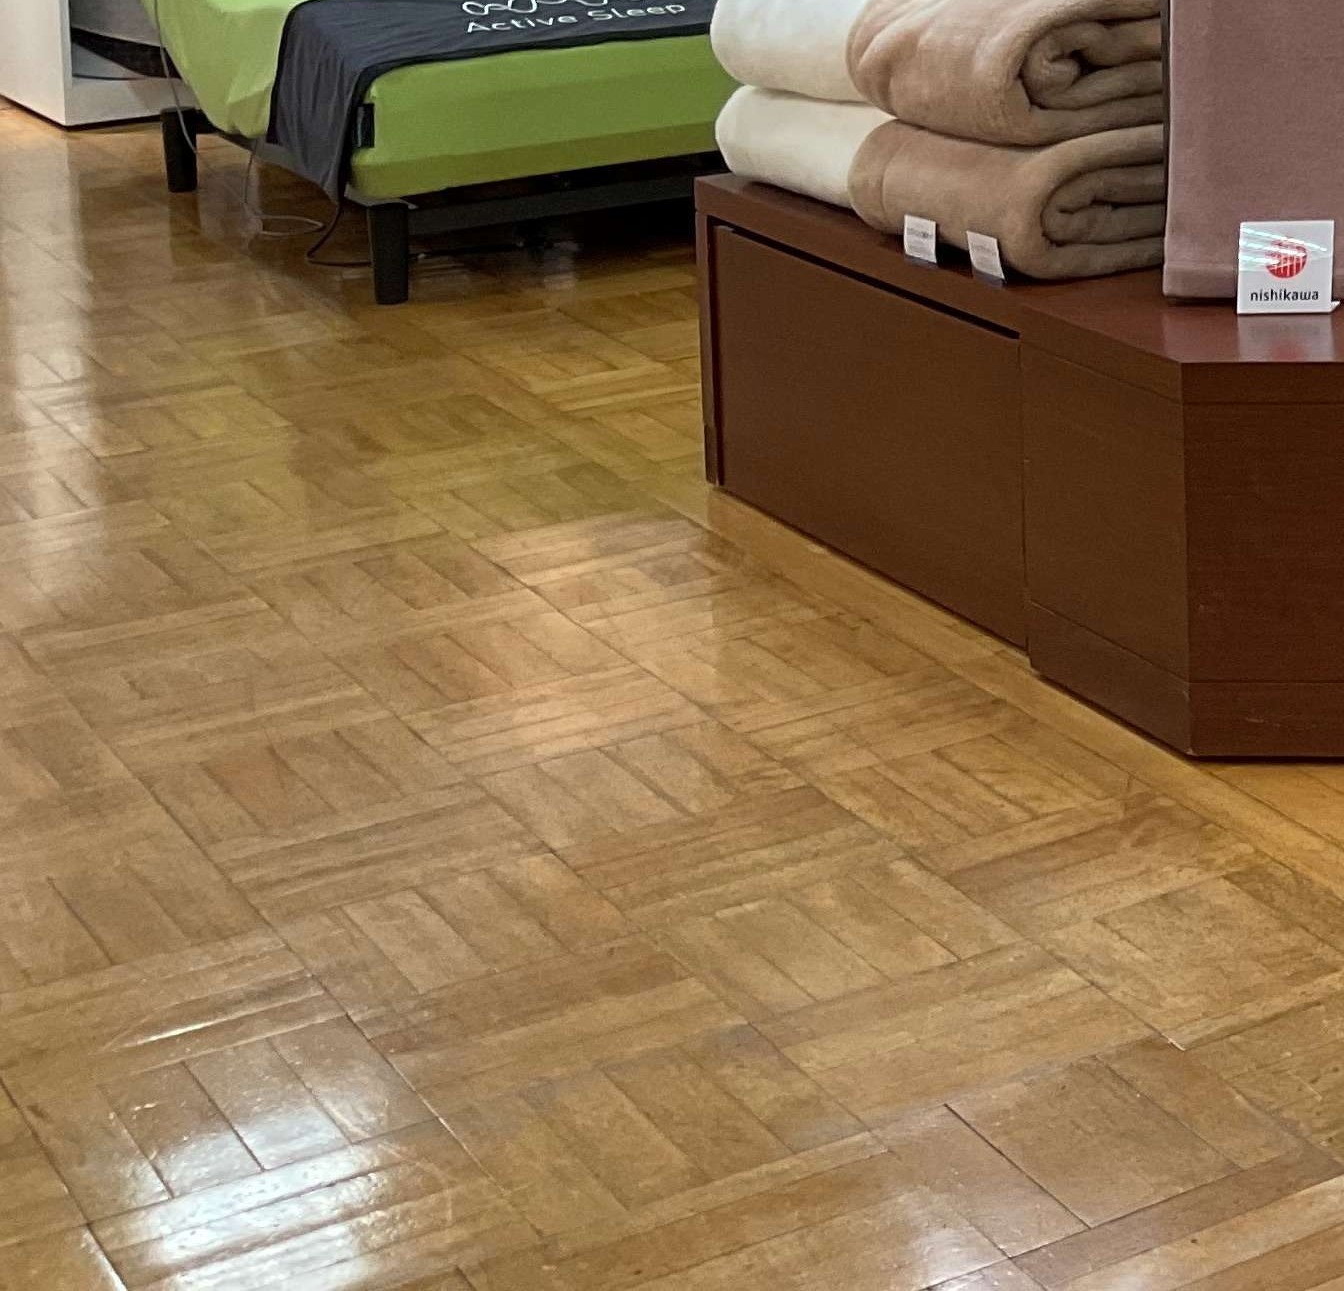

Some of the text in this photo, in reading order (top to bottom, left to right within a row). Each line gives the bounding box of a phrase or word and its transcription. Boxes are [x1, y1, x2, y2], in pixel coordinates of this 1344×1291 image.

[467, 4, 686, 33] Active Sleep
[1250, 289, 1320, 303] nishikawa
